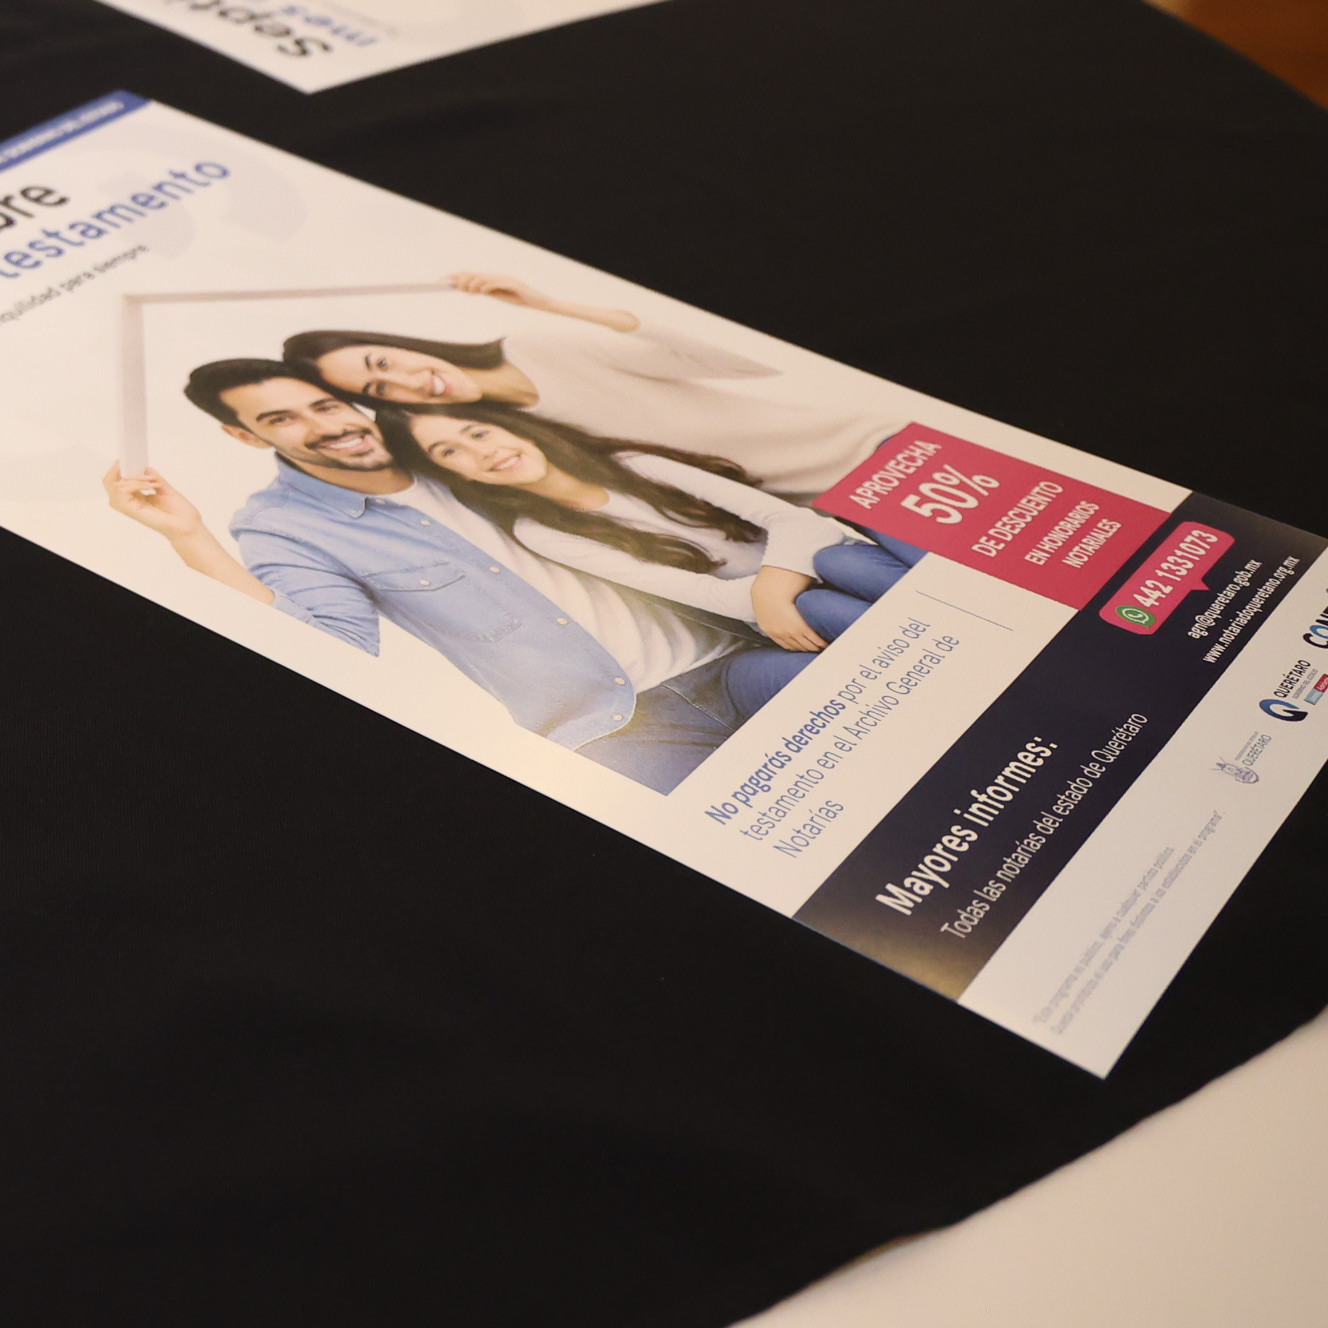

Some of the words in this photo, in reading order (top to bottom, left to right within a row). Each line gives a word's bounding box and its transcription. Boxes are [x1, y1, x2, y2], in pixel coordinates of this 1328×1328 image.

[59, 271, 95, 296] para
[93, 243, 150, 278] siempre
[849, 440, 943, 509] APROVECHA
[900, 463, 1000, 524] 50%
[971, 536, 1005, 557] DE
[988, 480, 1064, 541] DESCUENTO
[1024, 544, 1050, 565] EN
[1041, 500, 1100, 553] HONORARIOS
[1062, 518, 1122, 568] NOTARIALES
[1133, 579, 1174, 608] 442
[1155, 529, 1218, 581] 1331073
[1187, 559, 1262, 639] agn@queretaro.gob.mx
[1203, 555, 1300, 663] www.notariadoqueretano.org.mx
[936, 633, 960, 653] de
[886, 648, 946, 695] General
[1273, 658, 1311, 698] QUERÉTARO
[704, 801, 739, 825] No
[731, 750, 792, 808] pagarás
[782, 697, 846, 754] derechos
[838, 679, 867, 704] por
[859, 663, 882, 681] el
[872, 637, 911, 670] aviso
[901, 616, 931, 640] del
[834, 734, 858, 753] el
[843, 694, 900, 741] Archivo
[1090, 712, 1148, 765] Querétaro
[817, 750, 845, 771] en
[1080, 761, 1107, 780] de
[740, 768, 825, 841] testamento
[1052, 775, 1094, 816] estado
[773, 799, 845, 859] Notarías
[875, 823, 979, 916] Mayores
[953, 736, 1058, 827] informes:
[1032, 810, 1064, 836] del
[996, 832, 1046, 883] notarías
[973, 879, 1007, 902] las
[940, 897, 991, 939] Todas
